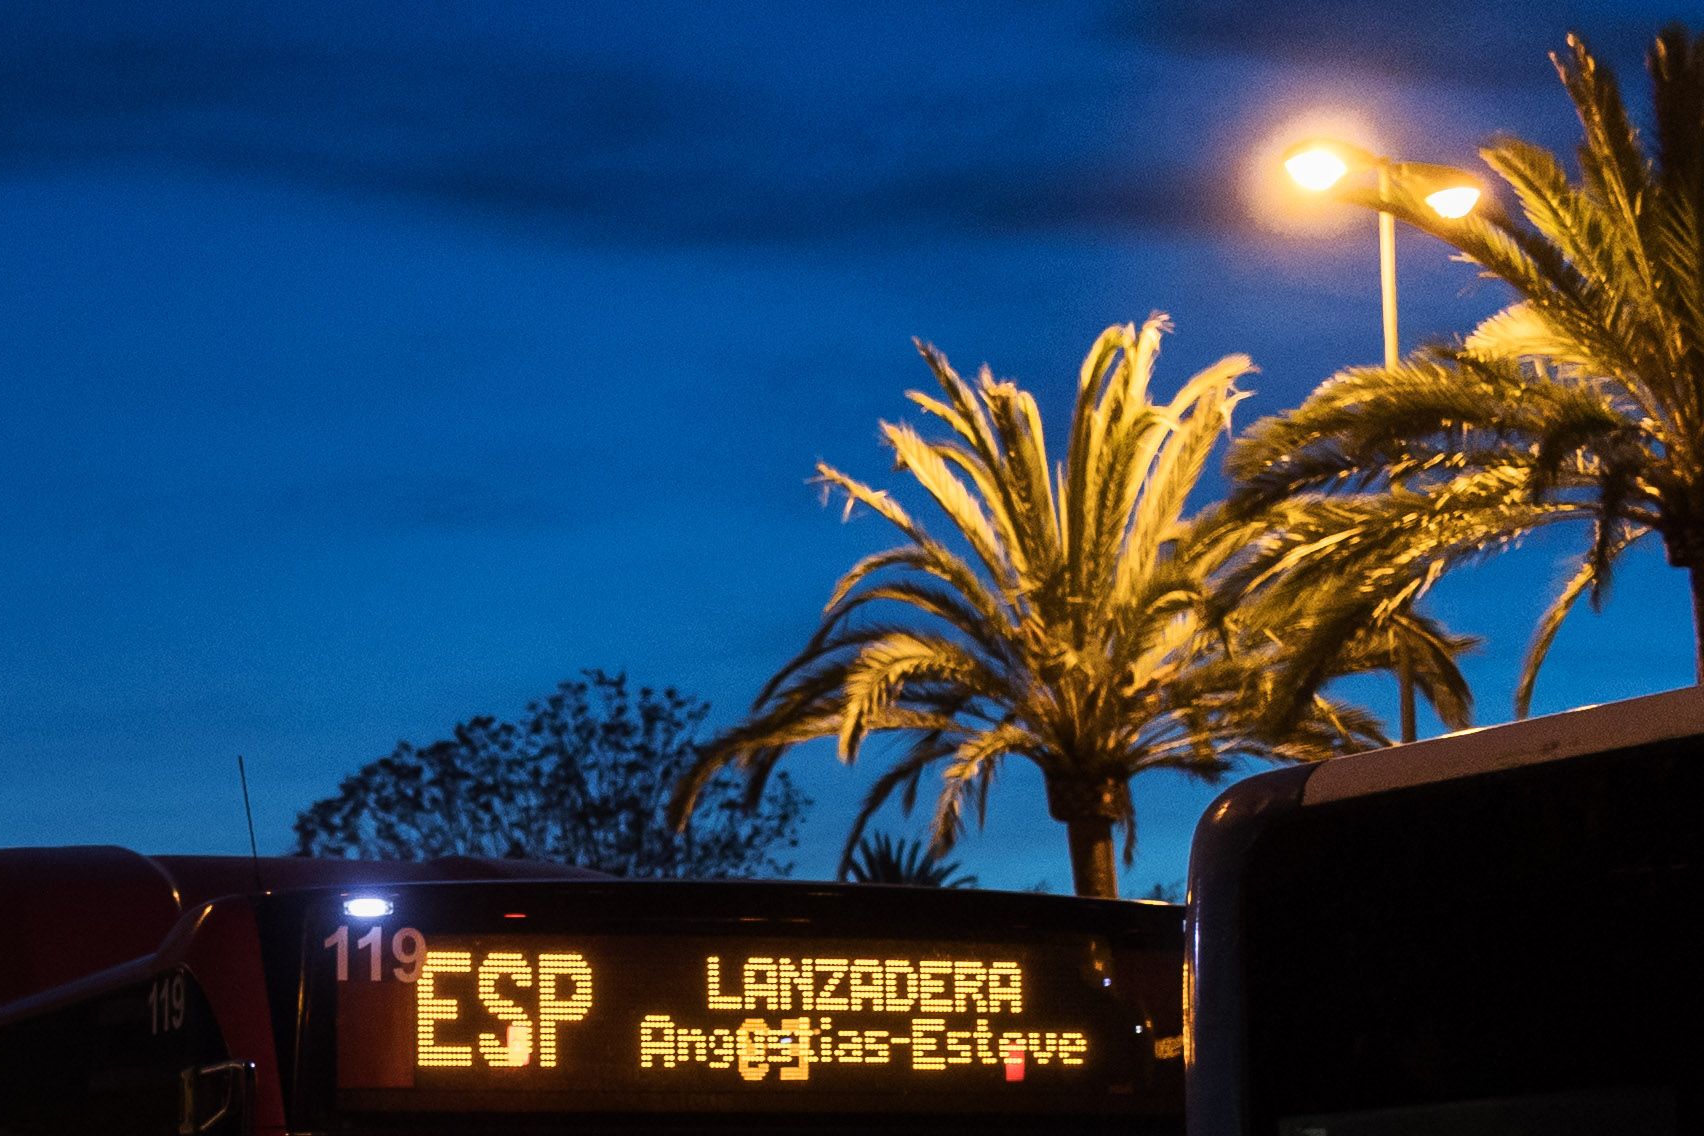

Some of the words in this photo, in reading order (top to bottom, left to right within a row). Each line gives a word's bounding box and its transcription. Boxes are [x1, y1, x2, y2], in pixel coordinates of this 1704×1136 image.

[323, 925, 428, 983] 119
[147, 974, 186, 1036] 119
[417, 951, 593, 1067] ESP
[706, 956, 1023, 1014] LANZADERA
